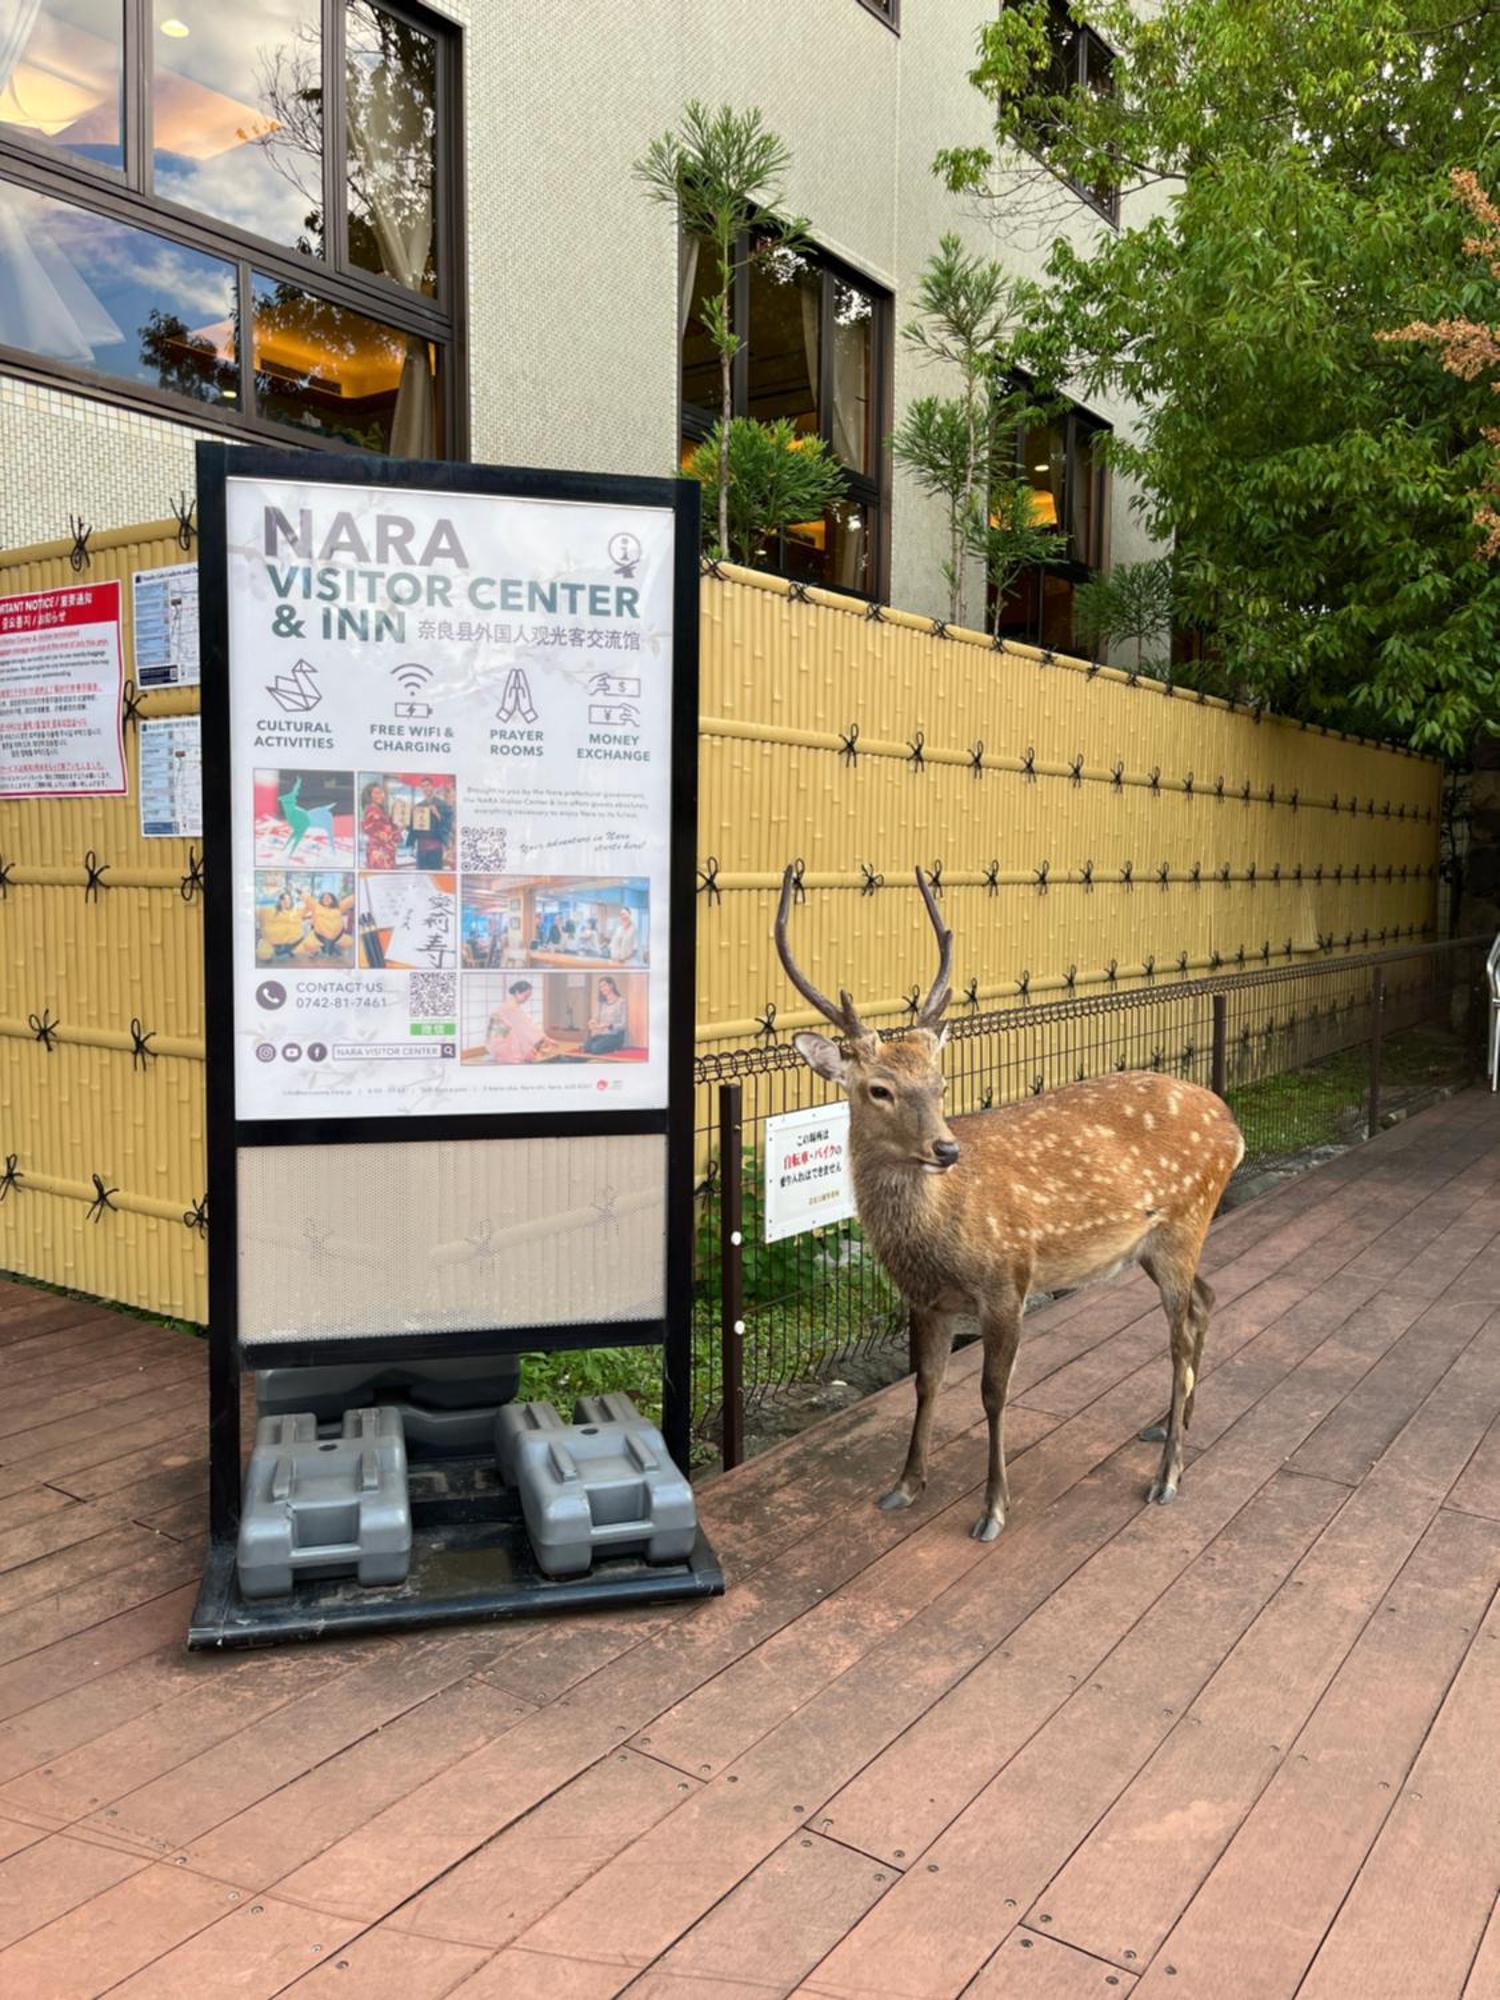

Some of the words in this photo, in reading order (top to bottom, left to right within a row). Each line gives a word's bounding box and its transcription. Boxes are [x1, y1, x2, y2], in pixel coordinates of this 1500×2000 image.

[264, 506, 470, 568] NARA
[266, 564, 453, 608] VISITOR
[467, 576, 641, 618] CENTER
[271, 604, 306, 639] &
[321, 608, 405, 643] INN
[417, 620, 641, 652] 奈良县外国人观光客交流馆
[256, 719, 332, 734] CULTURAL
[370, 724, 405, 736] FREE
[409, 727, 441, 738] WIFI
[444, 729, 454, 738] &
[254, 735, 334, 750] ACTIVITIES
[490, 729, 544, 742] PRAYER
[589, 733, 640, 746] MONEY
[373, 739, 451, 753] CHARGING
[490, 744, 544, 757] ROOMS
[577, 748, 651, 762] EXCHANGE
[296, 982, 361, 993] CONTACT
[366, 982, 383, 993] US
[296, 997, 385, 1008] 0742-81-7461
[336, 1048, 364, 1057] NARA
[366, 1048, 400, 1057] VISITOR
[402, 1047, 438, 1056] CENTER
